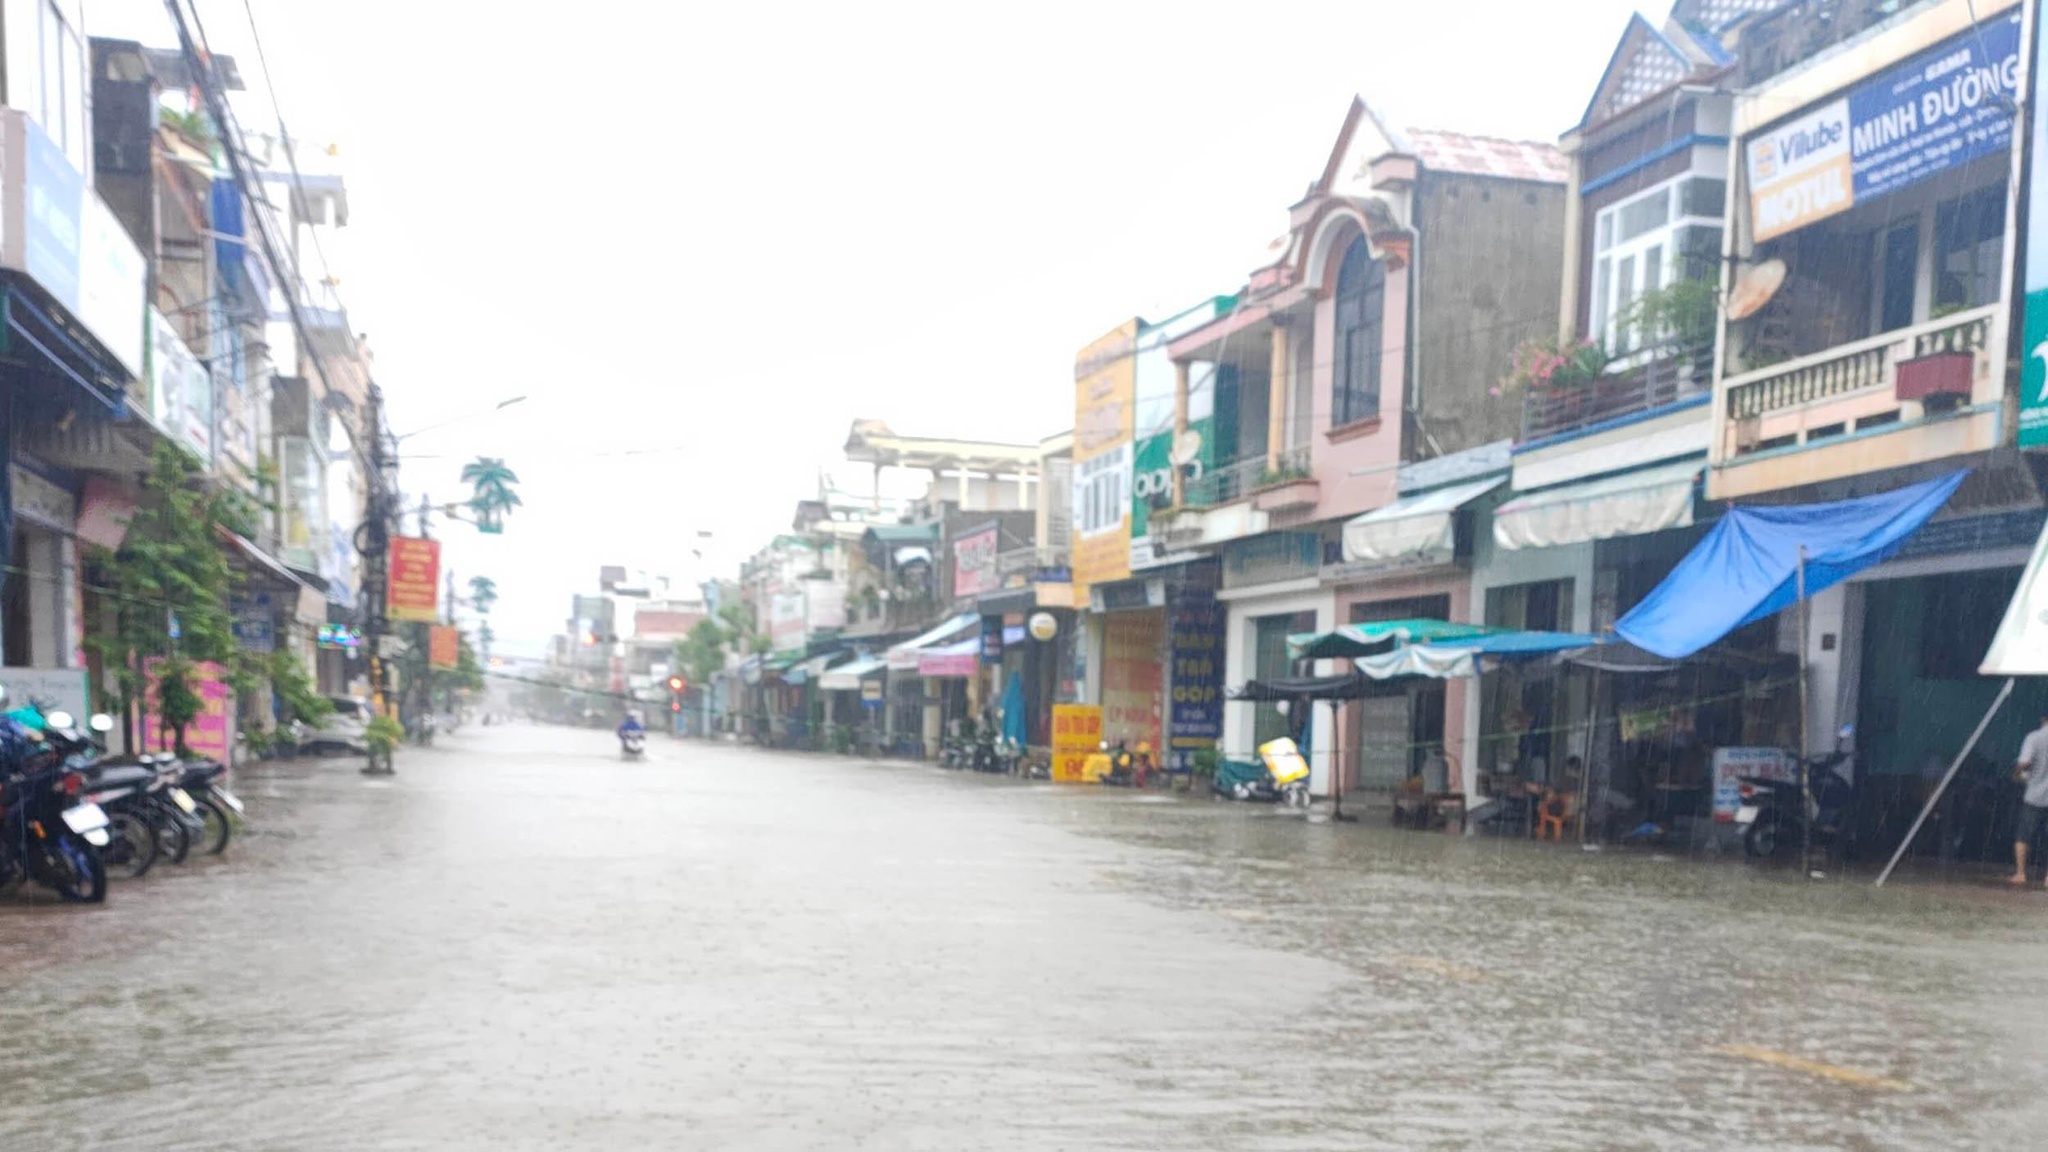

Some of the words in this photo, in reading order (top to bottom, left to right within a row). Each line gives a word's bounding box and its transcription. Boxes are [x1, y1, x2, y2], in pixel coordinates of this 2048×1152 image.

[1853, 101, 1918, 157] MINH
[1921, 54, 2019, 126] ĐƯỜNG
[1758, 166, 1847, 232] MOTUL
[1134, 459, 1203, 499] opo
